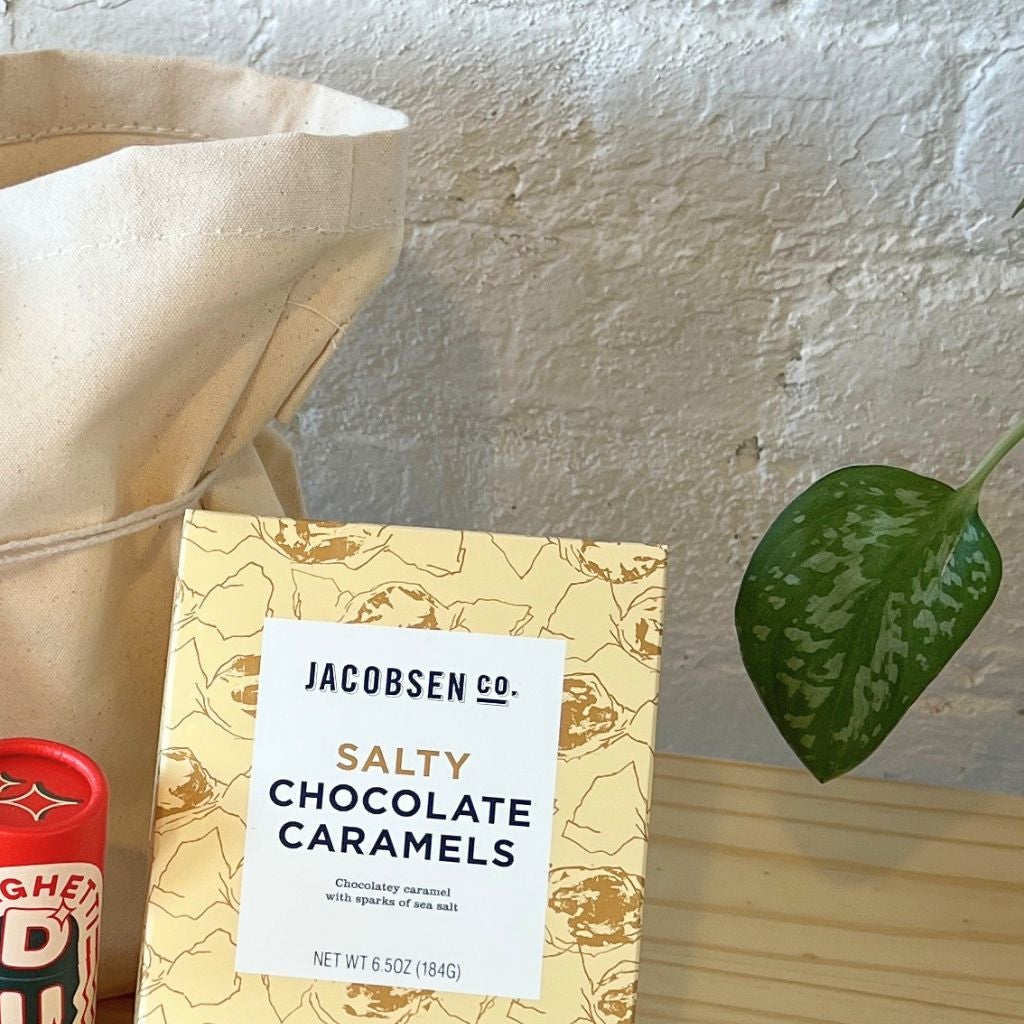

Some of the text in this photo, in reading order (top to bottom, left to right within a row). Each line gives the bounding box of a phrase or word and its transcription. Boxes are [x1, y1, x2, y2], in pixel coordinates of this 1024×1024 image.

[305, 661, 519, 701] JACOBSEN CO.
[336, 743, 471, 780] SALTY
[269, 779, 532, 827] CHOCOLATE
[278, 821, 515, 867] CARAMELS
[326, 891, 459, 912] with sparks of sea salt
[335, 878, 451, 897] Chocolatey caramel
[313, 950, 462, 983] NET WT 6.5OZ (184G)
